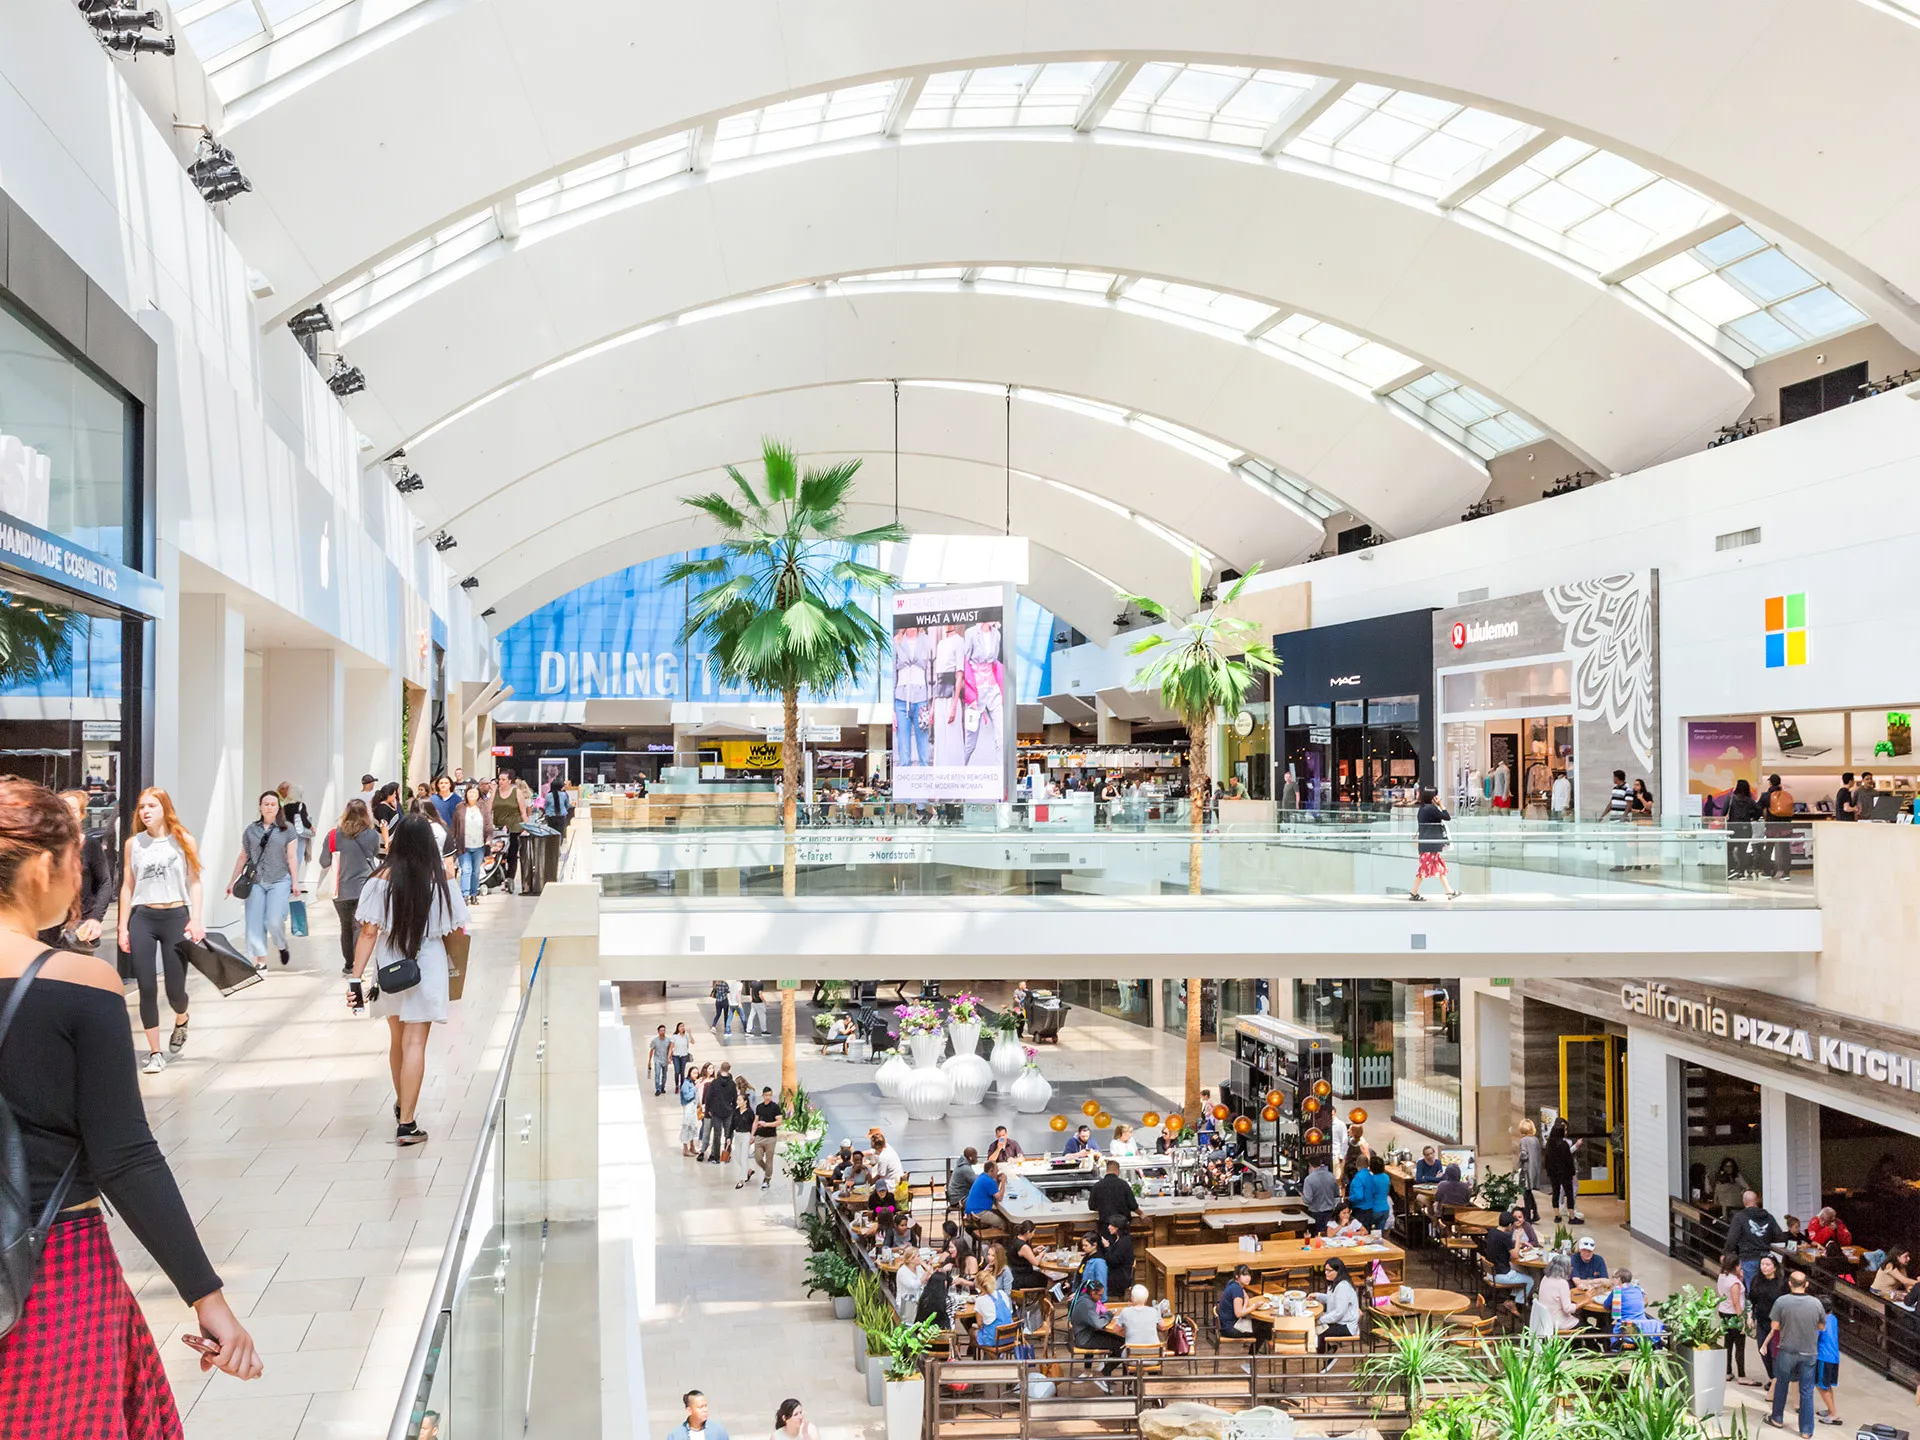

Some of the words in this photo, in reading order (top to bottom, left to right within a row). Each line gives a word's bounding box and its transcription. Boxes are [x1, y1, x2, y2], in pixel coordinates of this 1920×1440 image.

[0, 523, 63, 571] HANDMADE
[63, 550, 118, 592] COSMETICS
[916, 613, 941, 625] WHAT
[943, 614, 950, 623] A
[951, 611, 979, 622] WAIST
[1466, 620, 1518, 643] lululemon
[540, 650, 678, 696] DINING
[750, 743, 777, 756] WOW
[807, 851, 832, 862] Target
[876, 850, 916, 860] Nordstrom
[1620, 981, 1728, 1037] california
[1733, 1013, 1813, 1061] PIZZA
